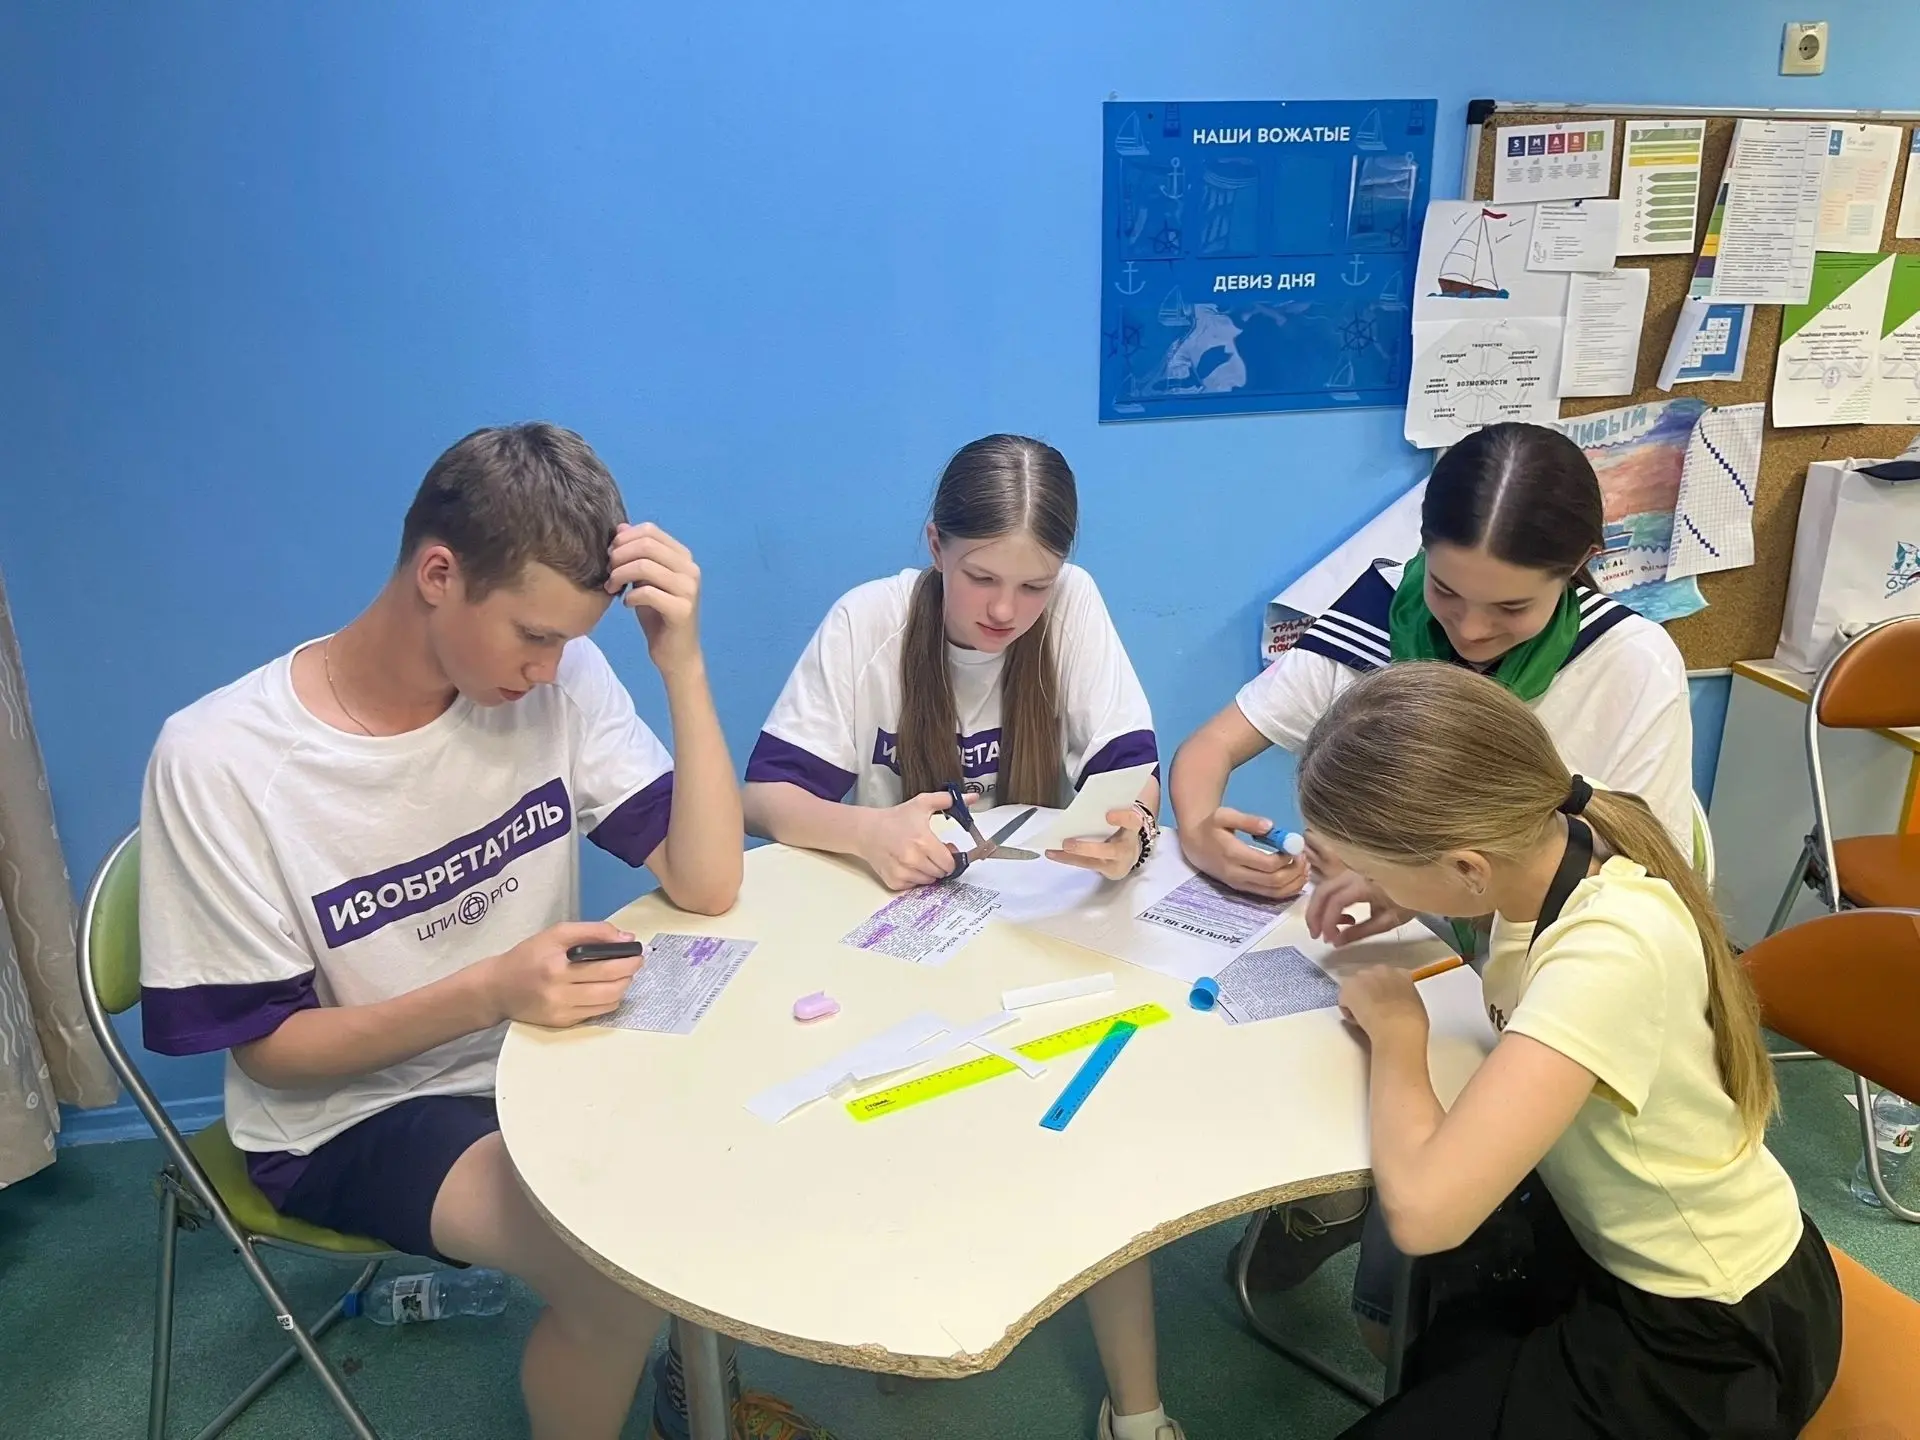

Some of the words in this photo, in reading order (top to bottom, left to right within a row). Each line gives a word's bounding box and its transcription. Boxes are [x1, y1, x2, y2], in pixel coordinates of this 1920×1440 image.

[1193, 128, 1251, 144] НАШИ
[1258, 126, 1351, 144] ВОЖАТЫЕ
[1513, 140, 1520, 148] S
[1532, 138, 1540, 146] M
[1553, 137, 1560, 145] A
[1574, 136, 1580, 144] R
[1636, 186, 1642, 195] 2
[1636, 198, 1642, 207] 3
[1634, 222, 1640, 231] 5
[1213, 275, 1273, 292] ДЕВИЗ
[1277, 273, 1316, 290] ДНЯ
[1456, 379, 1508, 387] ВОЗМОЖНОСТИ
[328, 800, 564, 932] ИЗОБРЕТАТЕЛЬ
[416, 913, 457, 942] ЦПИ
[490, 877, 520, 904] РГО
